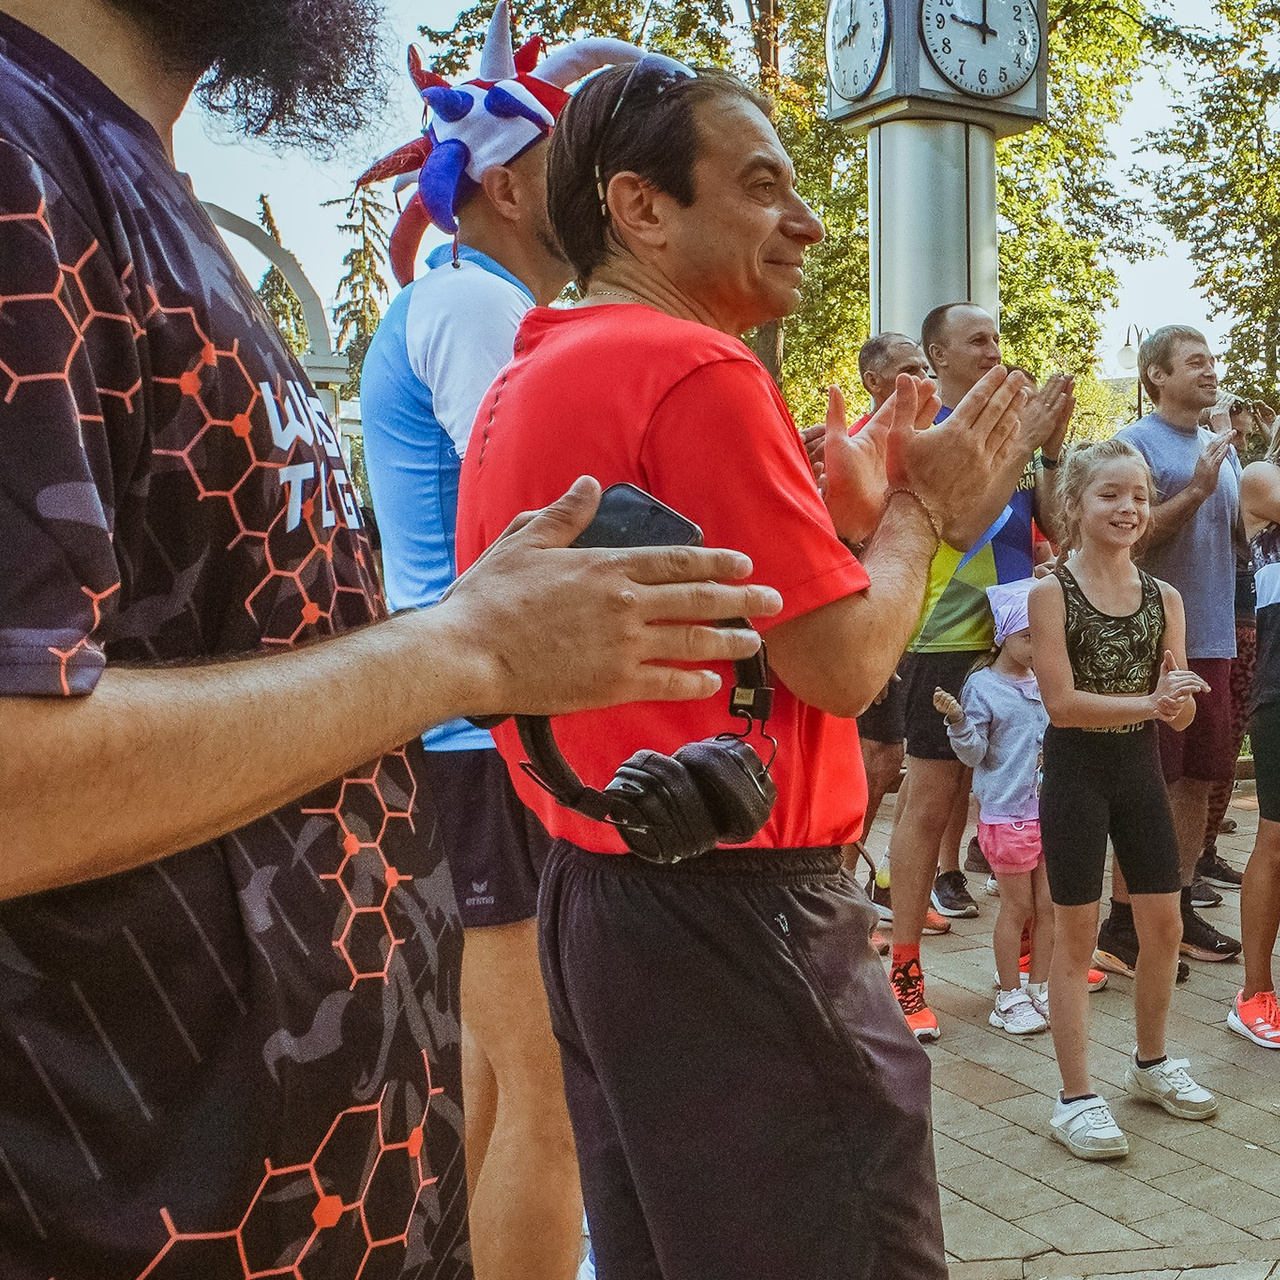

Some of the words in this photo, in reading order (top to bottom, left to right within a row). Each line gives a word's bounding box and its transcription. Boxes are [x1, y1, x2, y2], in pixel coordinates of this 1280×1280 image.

[935, 13, 945, 29] 9
[1013, 5, 1022, 22] 2
[942, 37, 952, 54] 8
[1018, 30, 1027, 46] 3
[958, 58, 966, 75] 7
[1013, 53, 1022, 68] 4
[978, 68, 987, 85] 6
[999, 67, 1007, 82] 5
